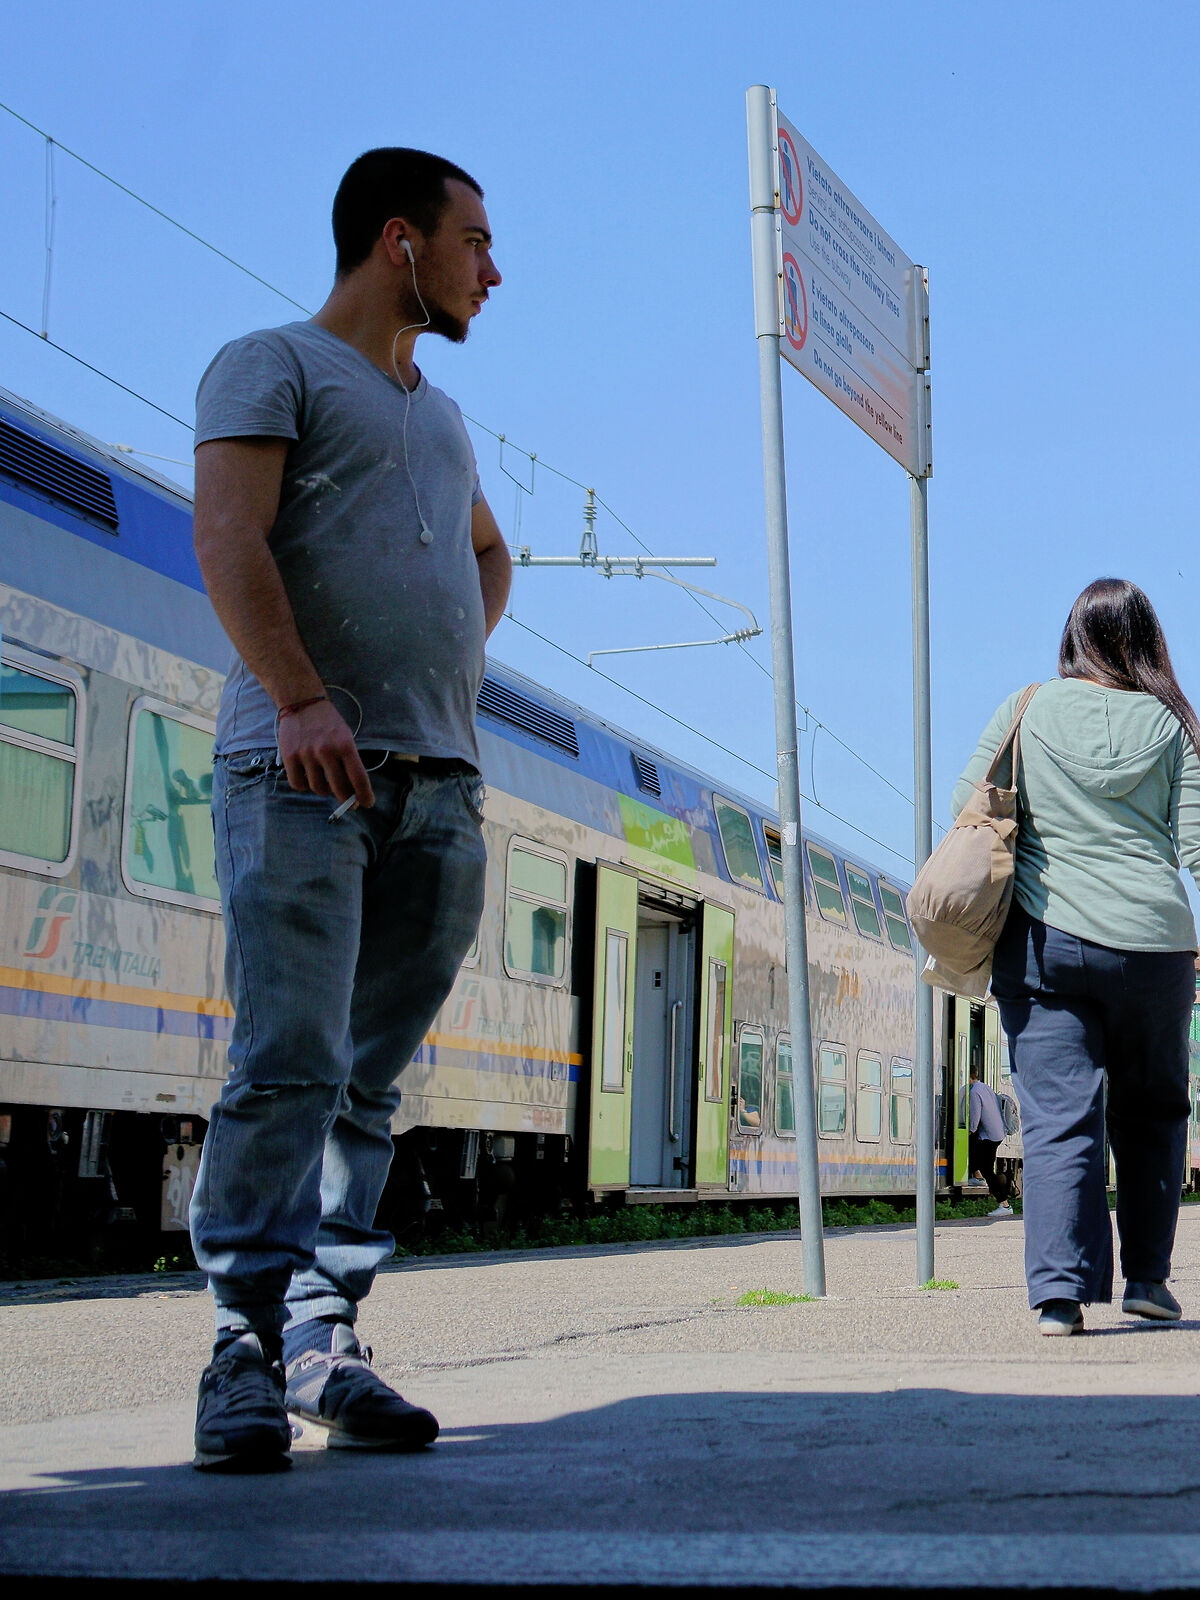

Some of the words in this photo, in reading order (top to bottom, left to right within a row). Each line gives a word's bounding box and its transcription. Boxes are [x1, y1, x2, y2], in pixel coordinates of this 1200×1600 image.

[807, 155, 832, 197] Vietato
[833, 191, 873, 242] attraversare
[878, 235, 895, 267] binari
[809, 207, 819, 232] Do
[820, 224, 831, 245] not
[832, 239, 849, 264] cross
[850, 254, 860, 276] the
[861, 271, 885, 305] railway
[886, 290, 900, 318] lines
[812, 302, 819, 322] la
[819, 310, 835, 339] linea
[816, 286, 838, 318] vietato
[839, 309, 875, 355] oltrepassare
[813, 348, 823, 369] Do
[823, 362, 833, 380] not
[834, 371, 842, 388] go
[843, 375, 864, 408] beyond
[864, 398, 874, 418] the
[875, 410, 892, 433] yellow
[893, 423, 903, 445] line
[73, 941, 162, 979] TRENITALIA
